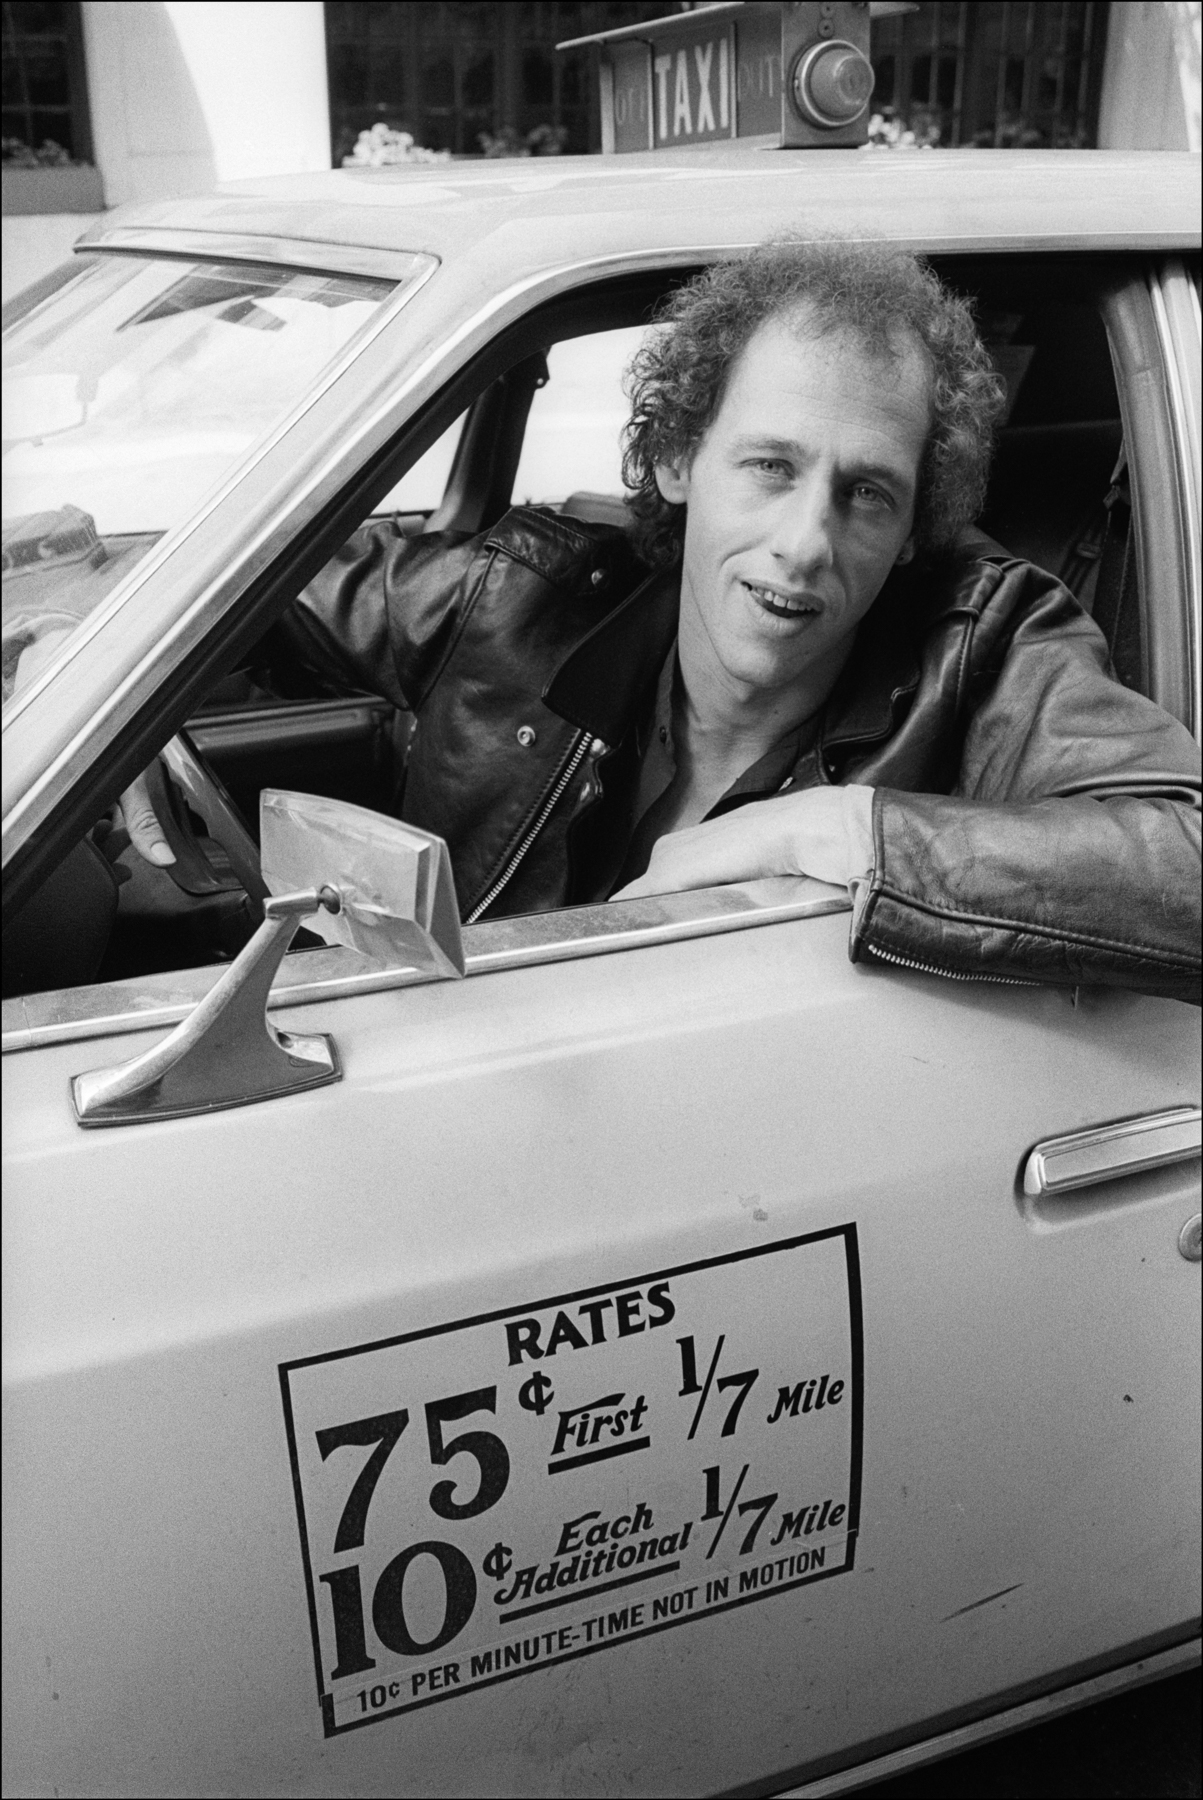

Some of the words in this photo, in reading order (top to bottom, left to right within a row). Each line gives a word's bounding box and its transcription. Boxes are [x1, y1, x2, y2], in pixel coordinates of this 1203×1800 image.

[655, 37, 729, 139] TAXI
[504, 1282, 676, 1366] RATES
[550, 1393, 649, 1455] First
[676, 1335, 760, 1440] 1/7
[766, 1375, 846, 1424] Mile
[493, 1522, 694, 1605] Additional
[700, 1464, 779, 1560] 1/7
[770, 1500, 847, 1547] Mile
[554, 1503, 655, 1557] Each
[356, 1681, 401, 1713] 10¢
[411, 1663, 461, 1697] PER
[652, 1586, 699, 1621] NOT
[705, 1577, 730, 1604] IN
[738, 1546, 826, 1593] MOTION
